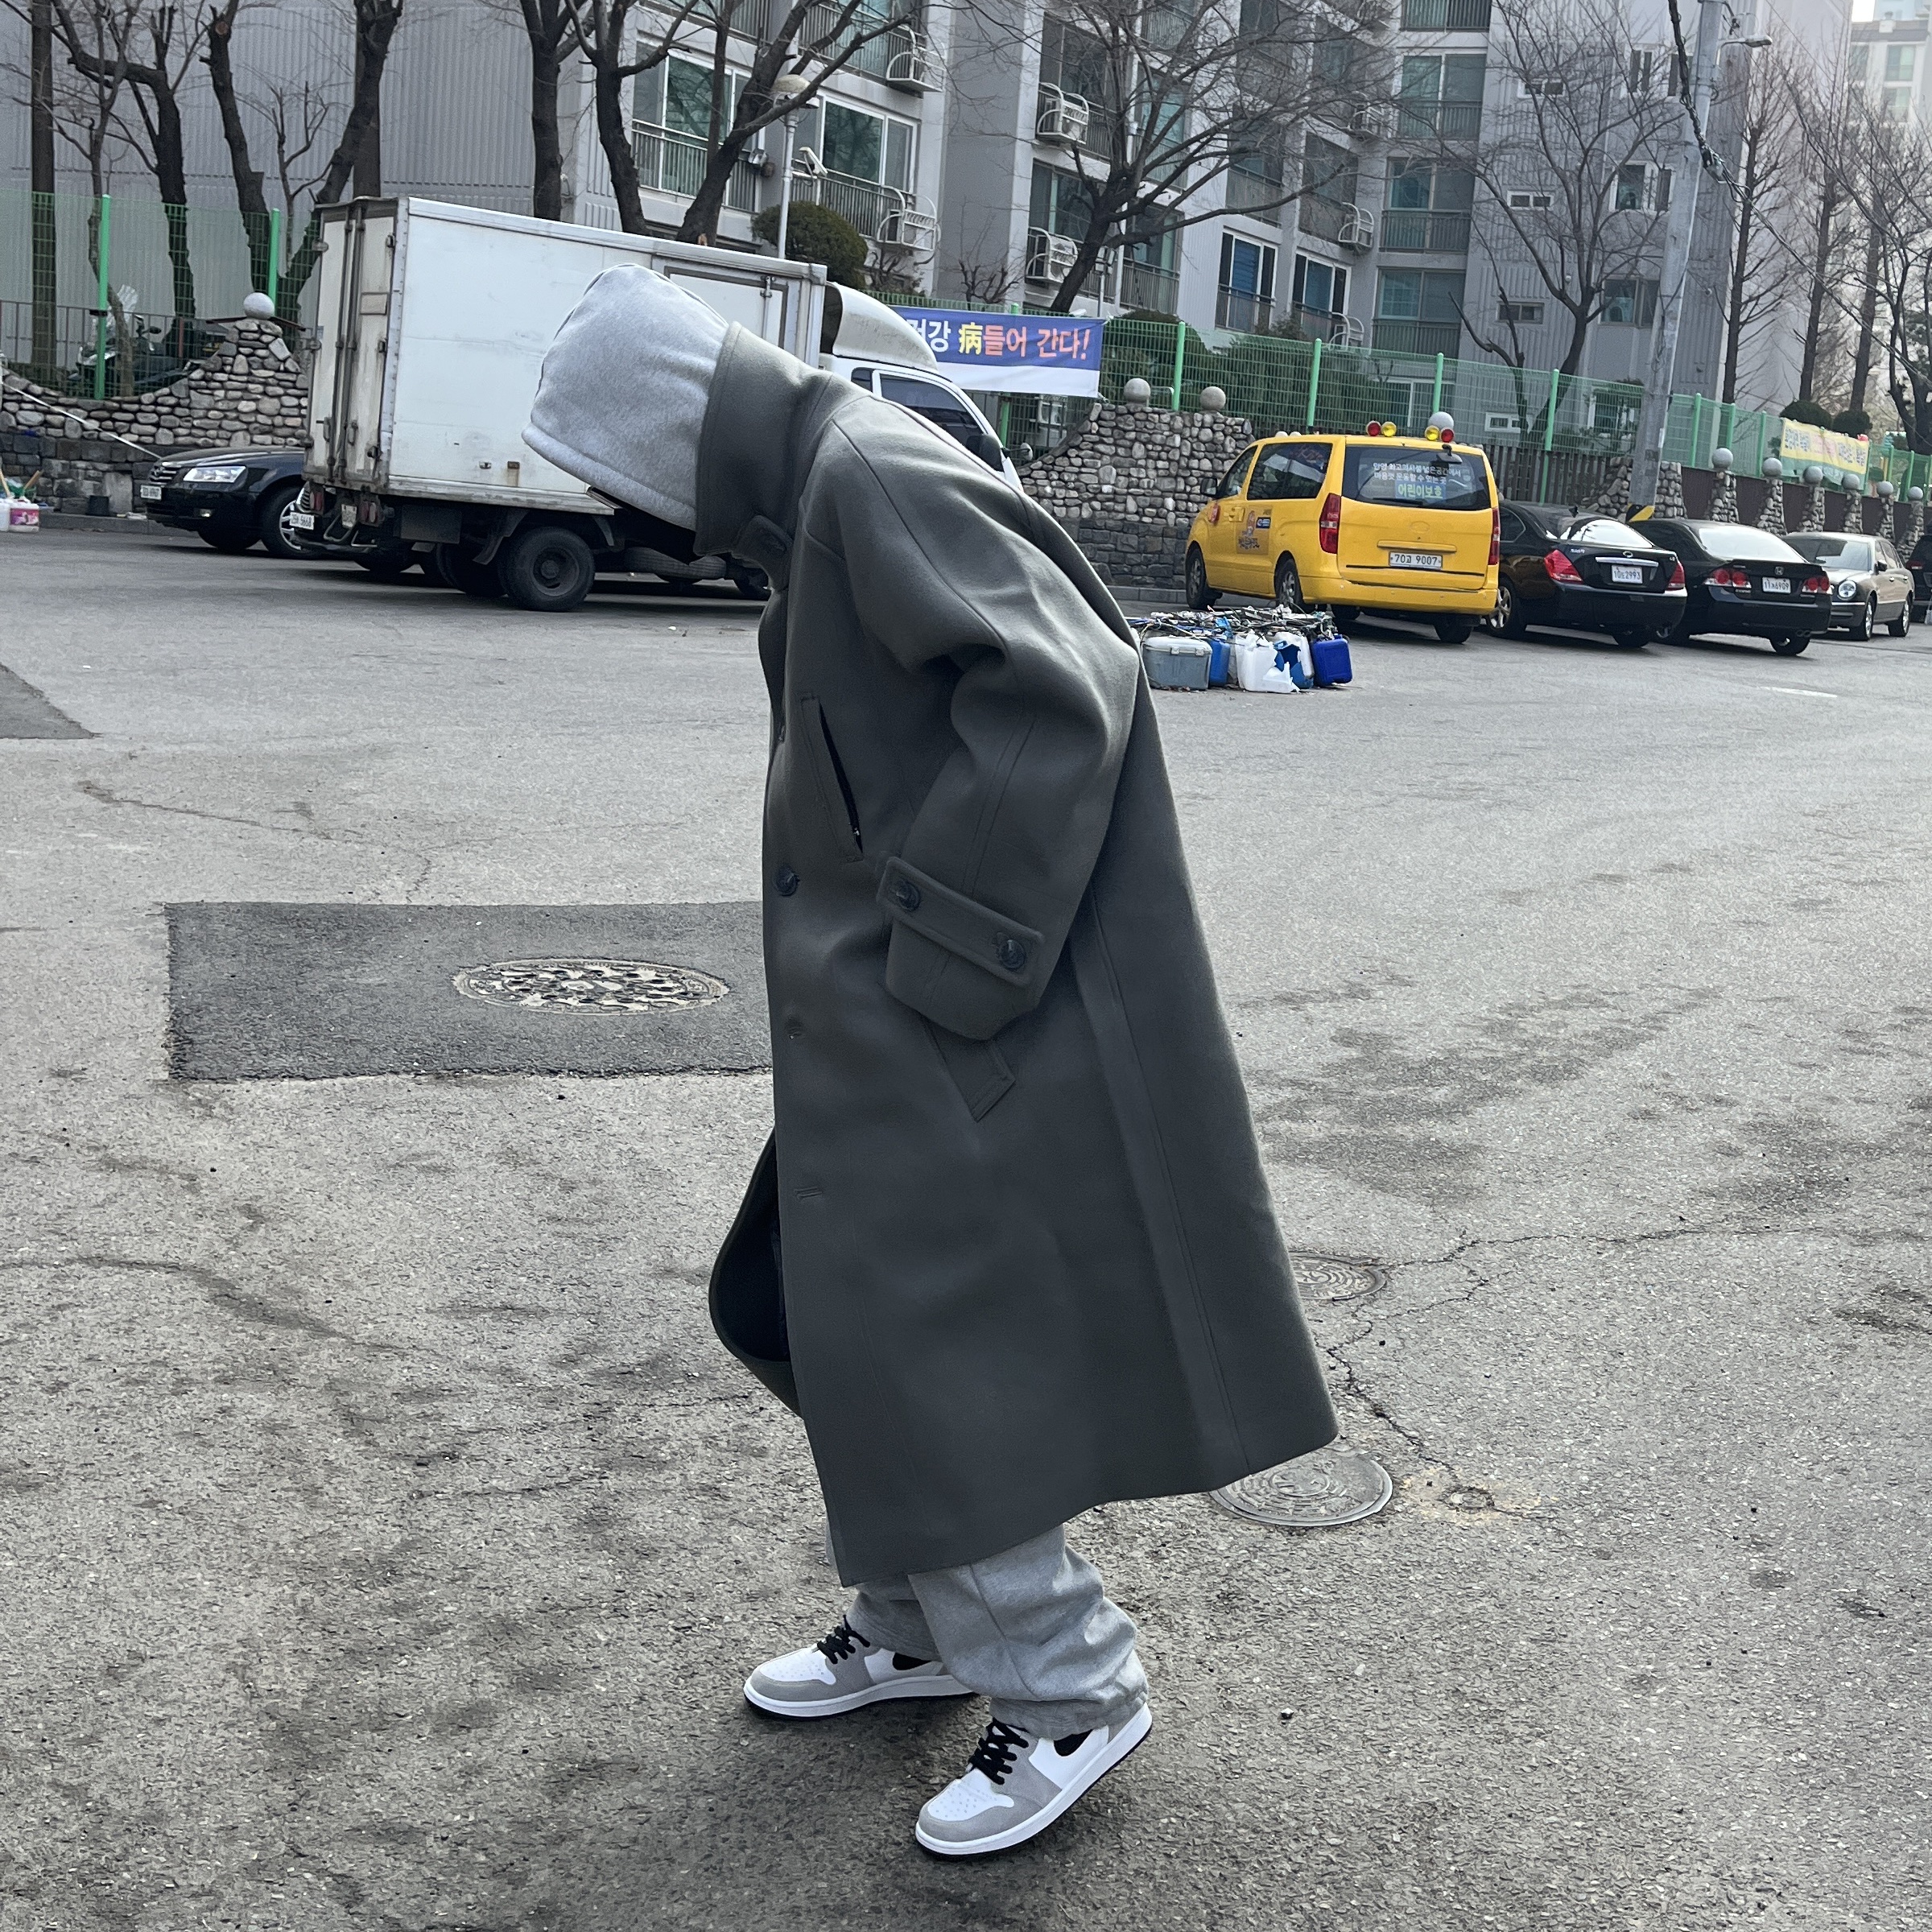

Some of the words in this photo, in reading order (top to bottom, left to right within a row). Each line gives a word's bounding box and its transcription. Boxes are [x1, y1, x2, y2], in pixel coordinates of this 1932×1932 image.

[958, 322, 1027, 357] 病들어
[1036, 328, 1091, 360] 간다!
[1397, 483, 1443, 499] 어린이보호
[1415, 555, 1438, 565] 9007
